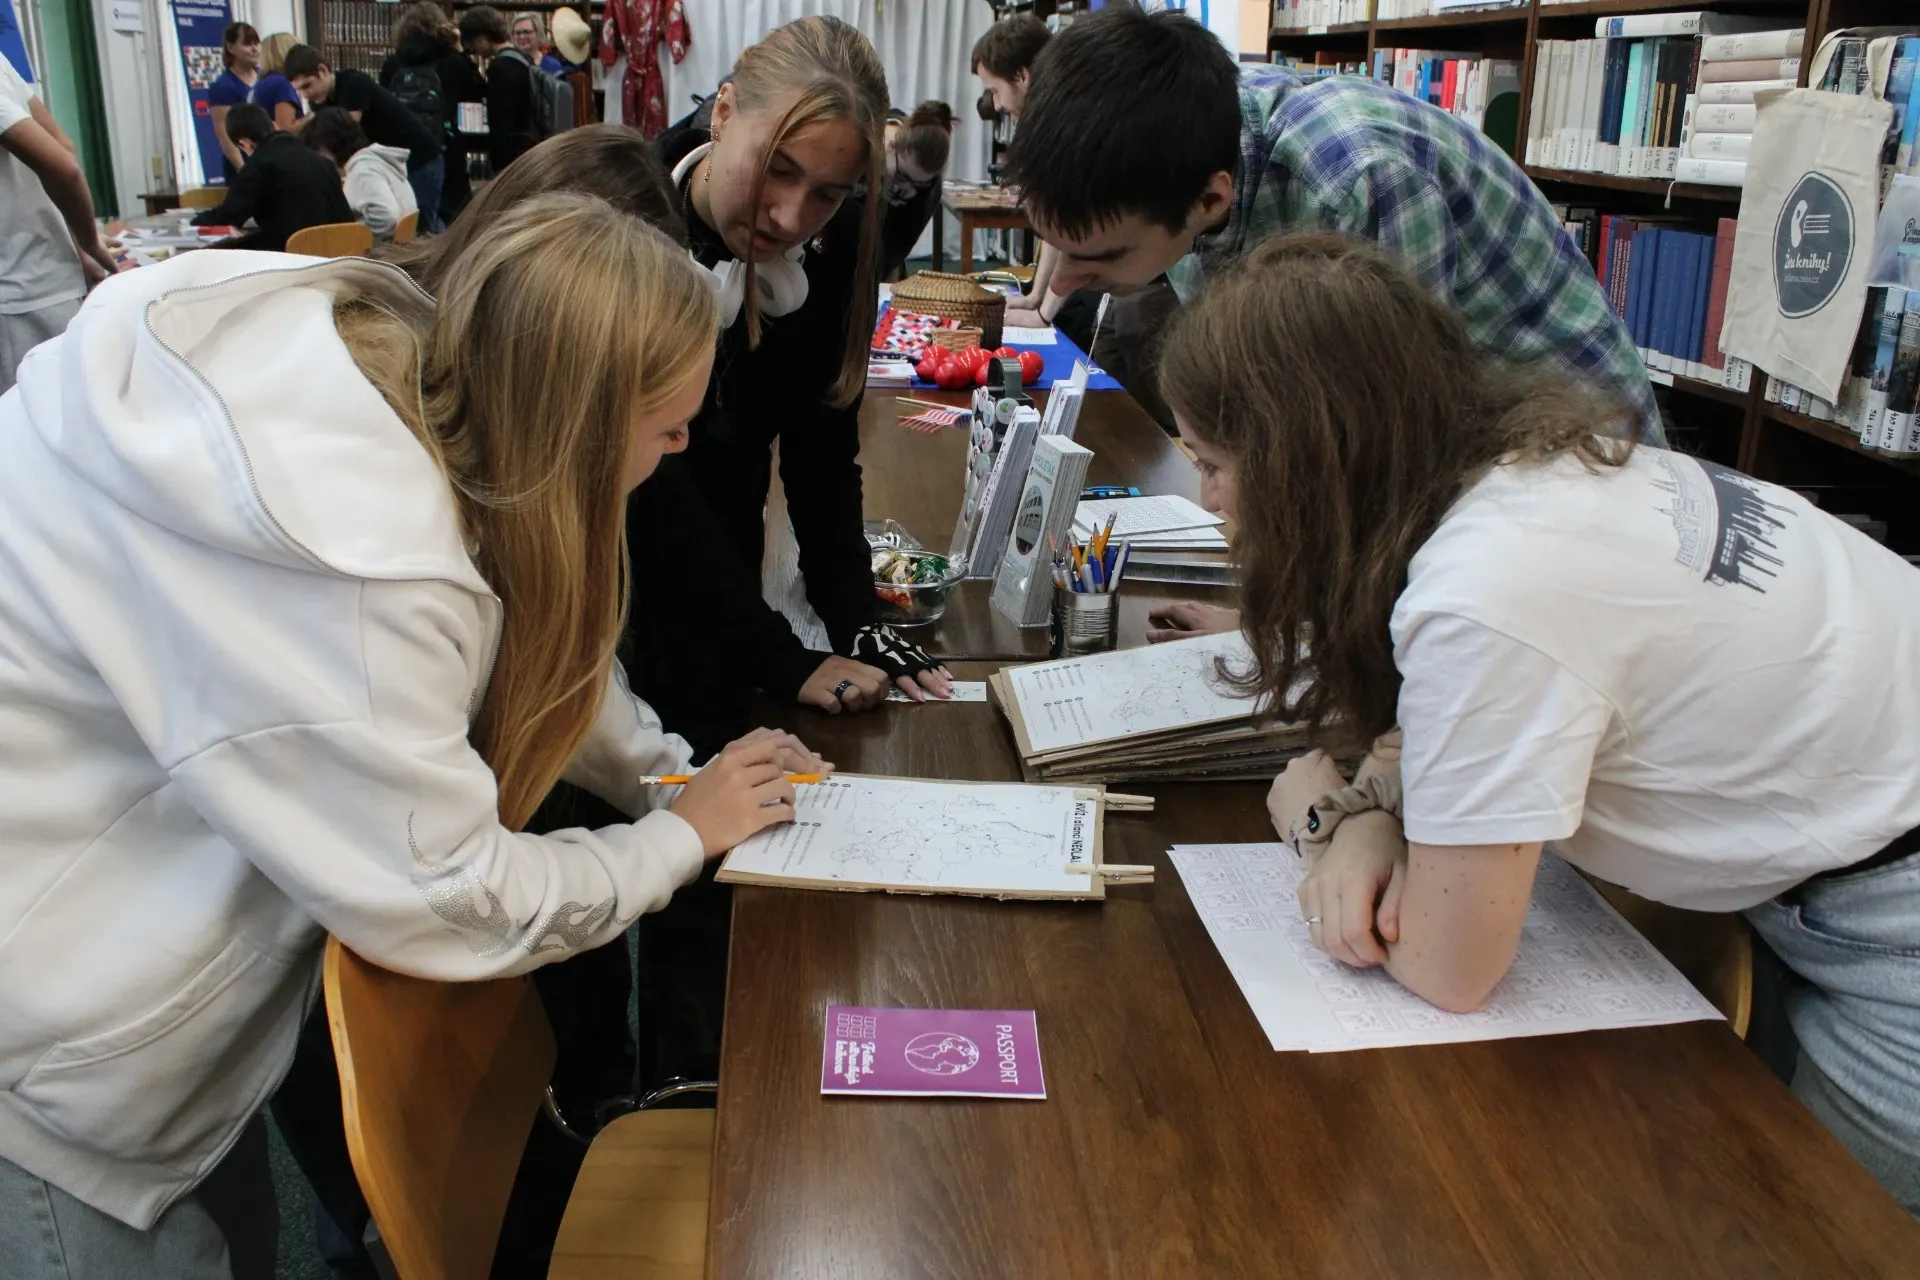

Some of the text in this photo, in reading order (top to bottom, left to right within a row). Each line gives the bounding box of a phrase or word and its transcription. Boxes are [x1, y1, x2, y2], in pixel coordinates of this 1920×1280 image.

[1796, 252, 1832, 274] knihy!
[1075, 802, 1089, 816] KVÍZ
[1072, 820, 1085, 840] aliancí
[1070, 840, 1083, 863] NEOLAi
[995, 1024, 1019, 1086] PASSPORT
